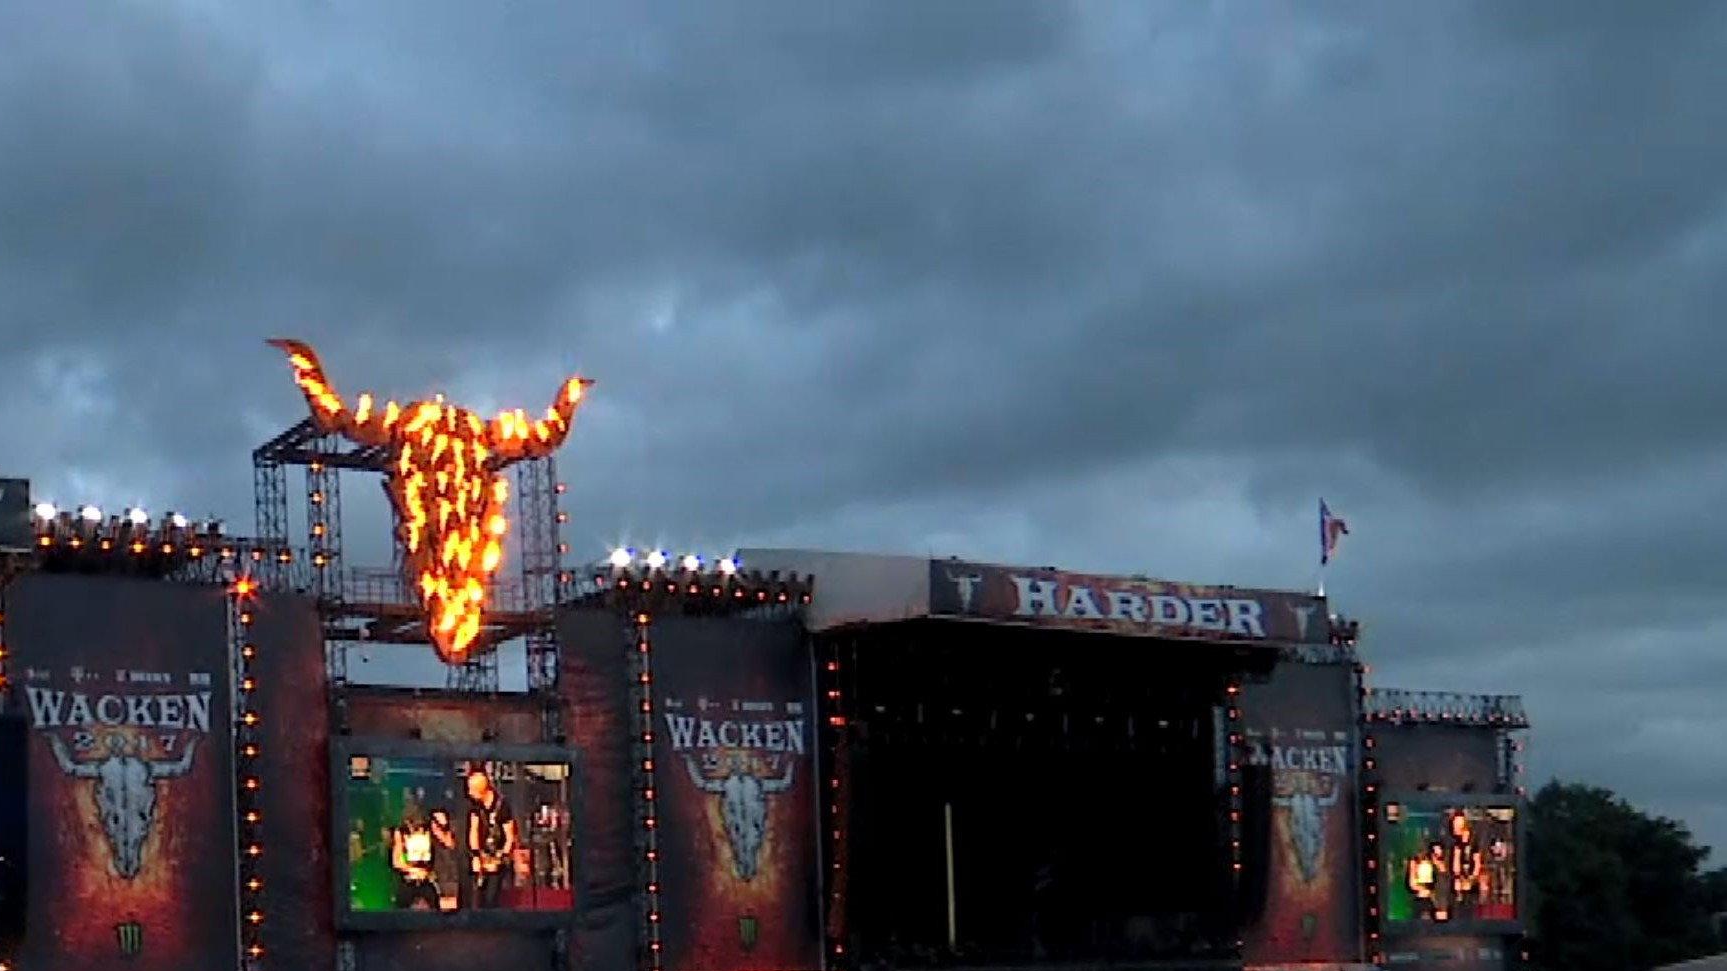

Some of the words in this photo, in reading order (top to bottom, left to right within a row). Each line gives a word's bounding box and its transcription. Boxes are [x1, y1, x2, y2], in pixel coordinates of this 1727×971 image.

[1012, 574, 1267, 638] HARDER
[24, 684, 212, 733] WACKEN
[663, 712, 805, 755] WACKEN
